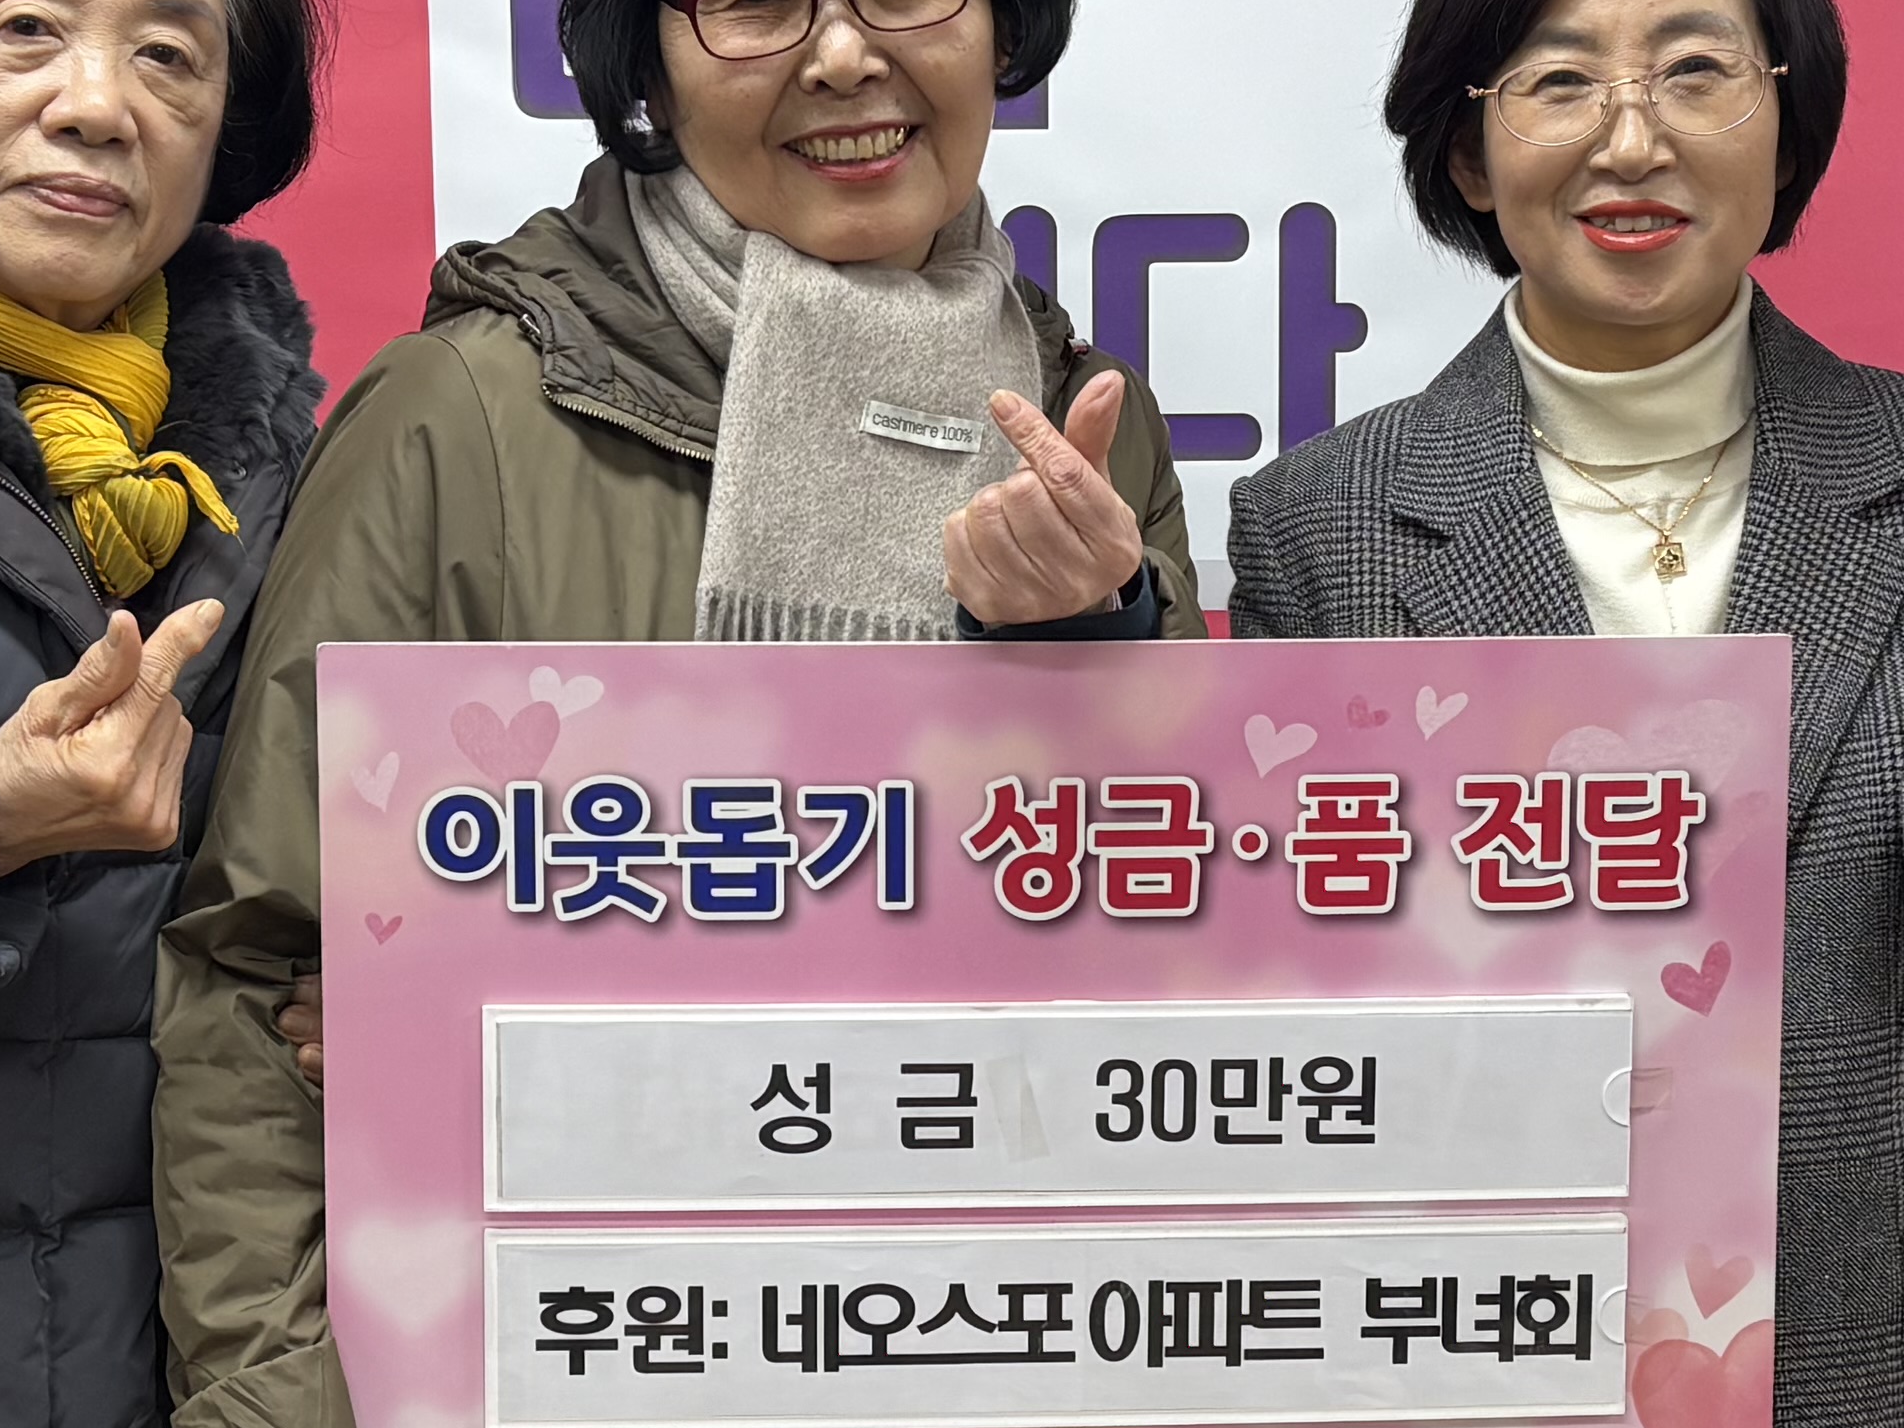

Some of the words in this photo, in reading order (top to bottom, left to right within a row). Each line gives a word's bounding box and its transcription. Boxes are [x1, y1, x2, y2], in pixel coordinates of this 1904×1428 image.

[871, 411, 939, 439] cashmere
[941, 424, 974, 444] 100%
[420, 778, 916, 918] 이웃돕기
[966, 775, 1412, 918] 성금·품
[1454, 771, 1705, 912] 전달
[1094, 1056, 1378, 1146] 30만원
[534, 1285, 728, 1376] 후원:
[1360, 1273, 1593, 1365] 부녀회
